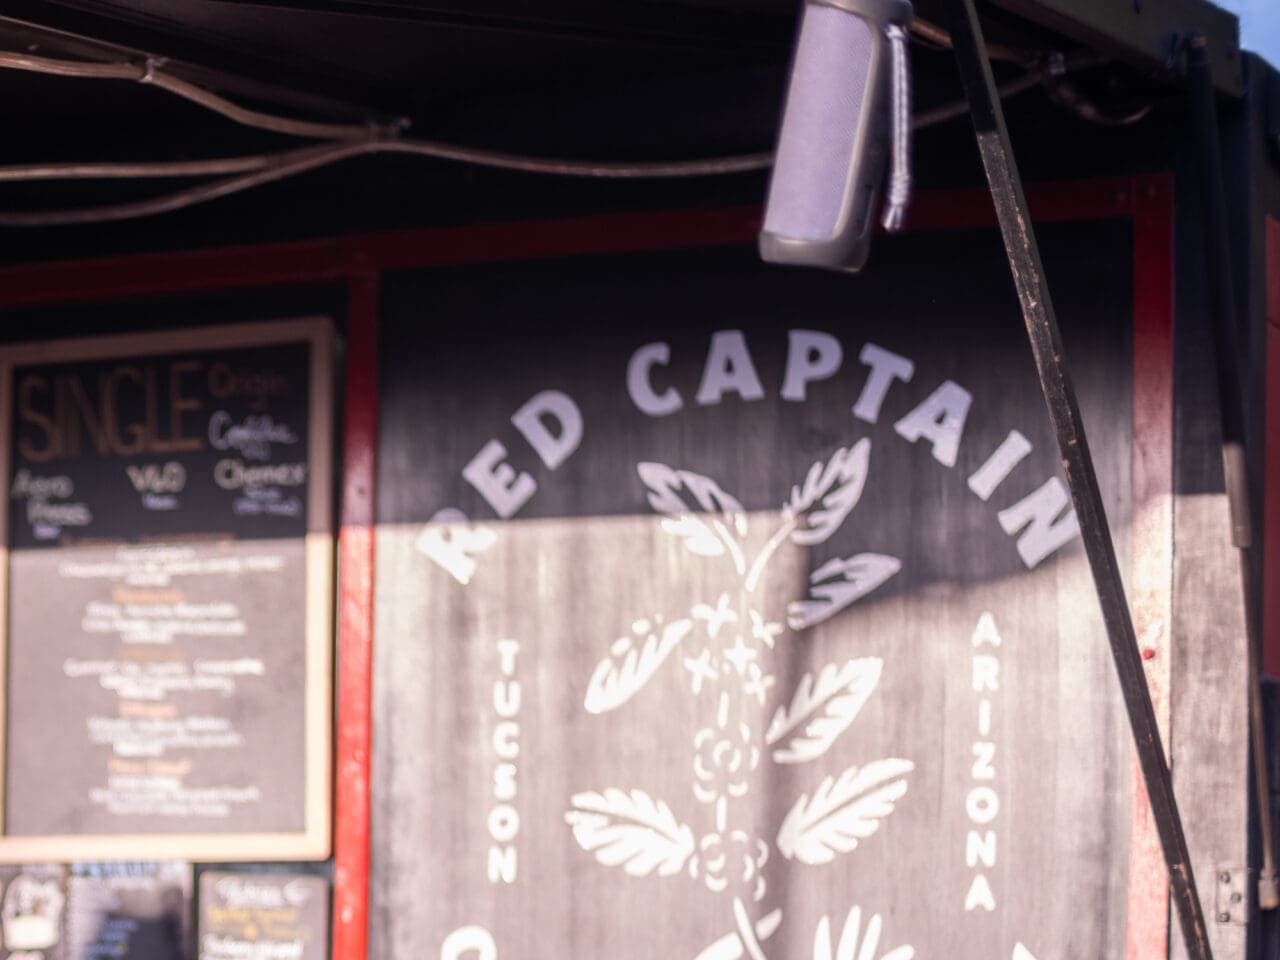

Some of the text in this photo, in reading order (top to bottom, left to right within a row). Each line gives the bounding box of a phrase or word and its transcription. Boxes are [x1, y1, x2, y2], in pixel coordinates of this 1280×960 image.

[417, 329, 1081, 585] RED CAPTAIN
[486, 639, 521, 884] TUCSON
[963, 611, 1002, 911] ARIZONA
